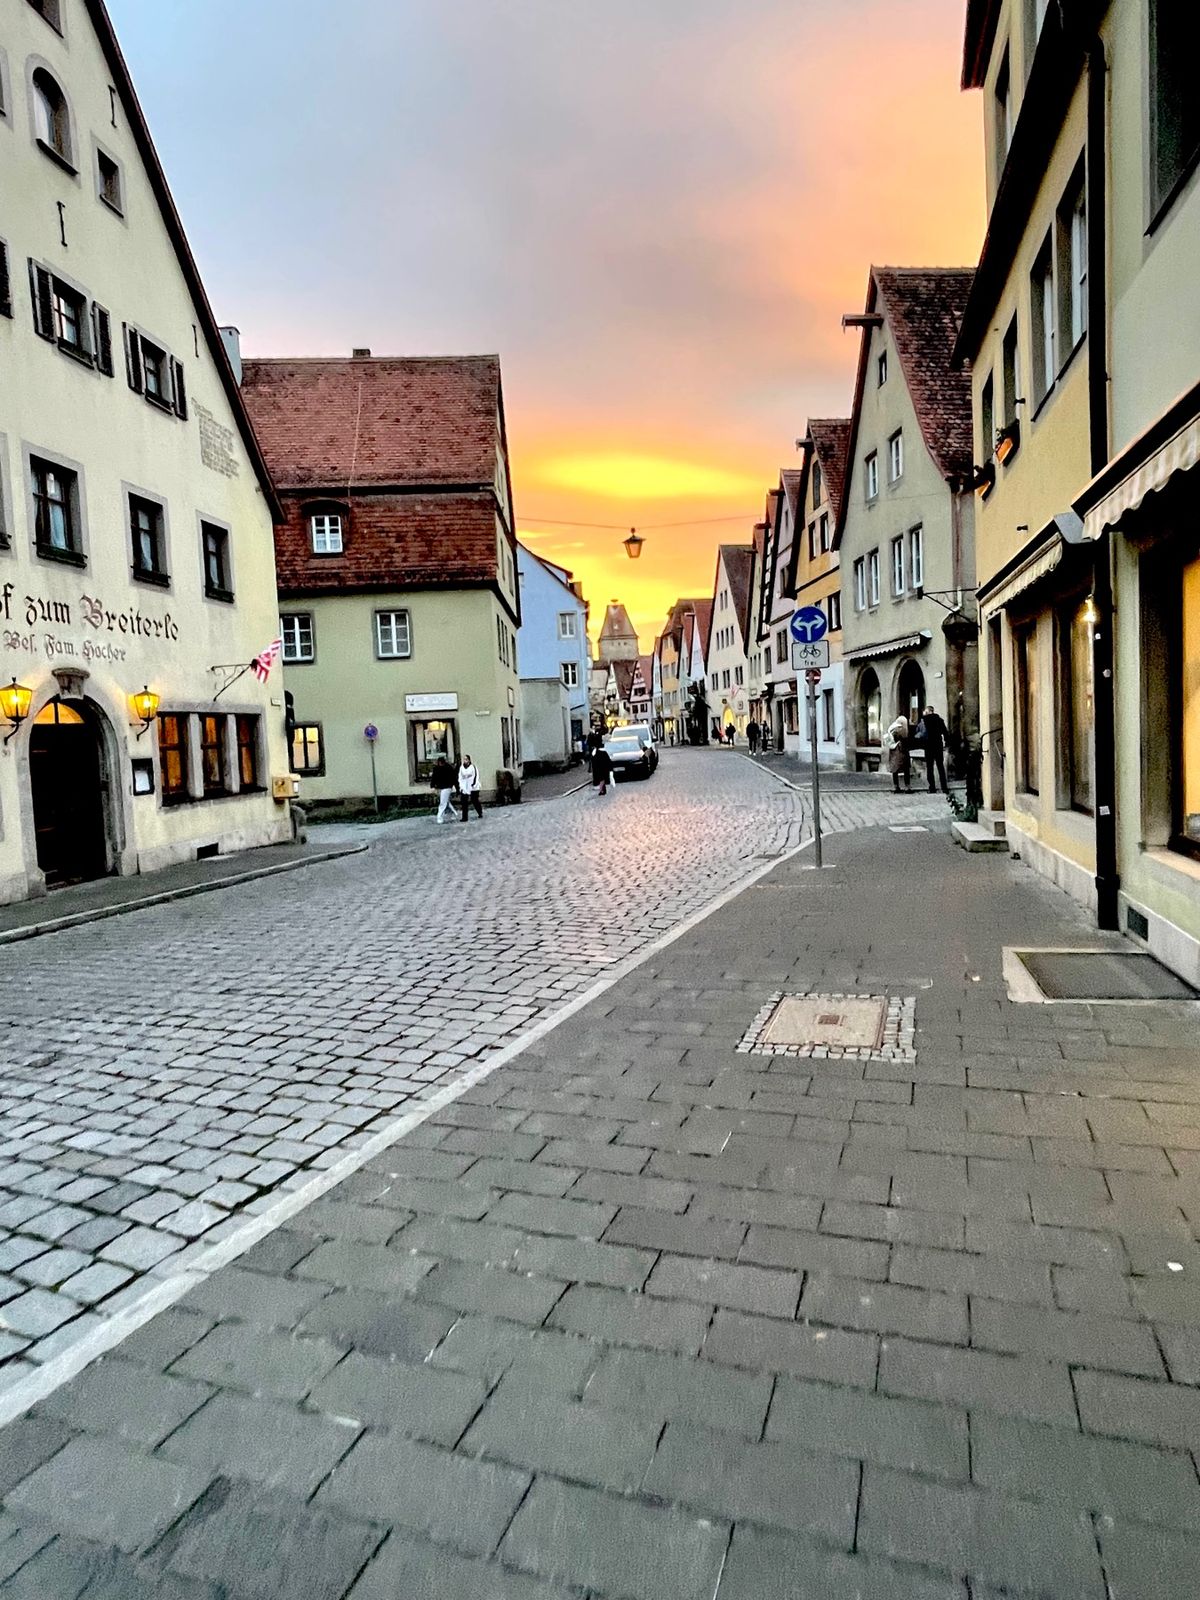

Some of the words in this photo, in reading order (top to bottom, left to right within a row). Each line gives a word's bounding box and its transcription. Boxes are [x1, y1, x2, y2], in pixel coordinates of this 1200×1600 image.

[24, 595, 71, 626] zum
[79, 594, 179, 641] Breiterle
[45, 633, 79, 660] Fam.
